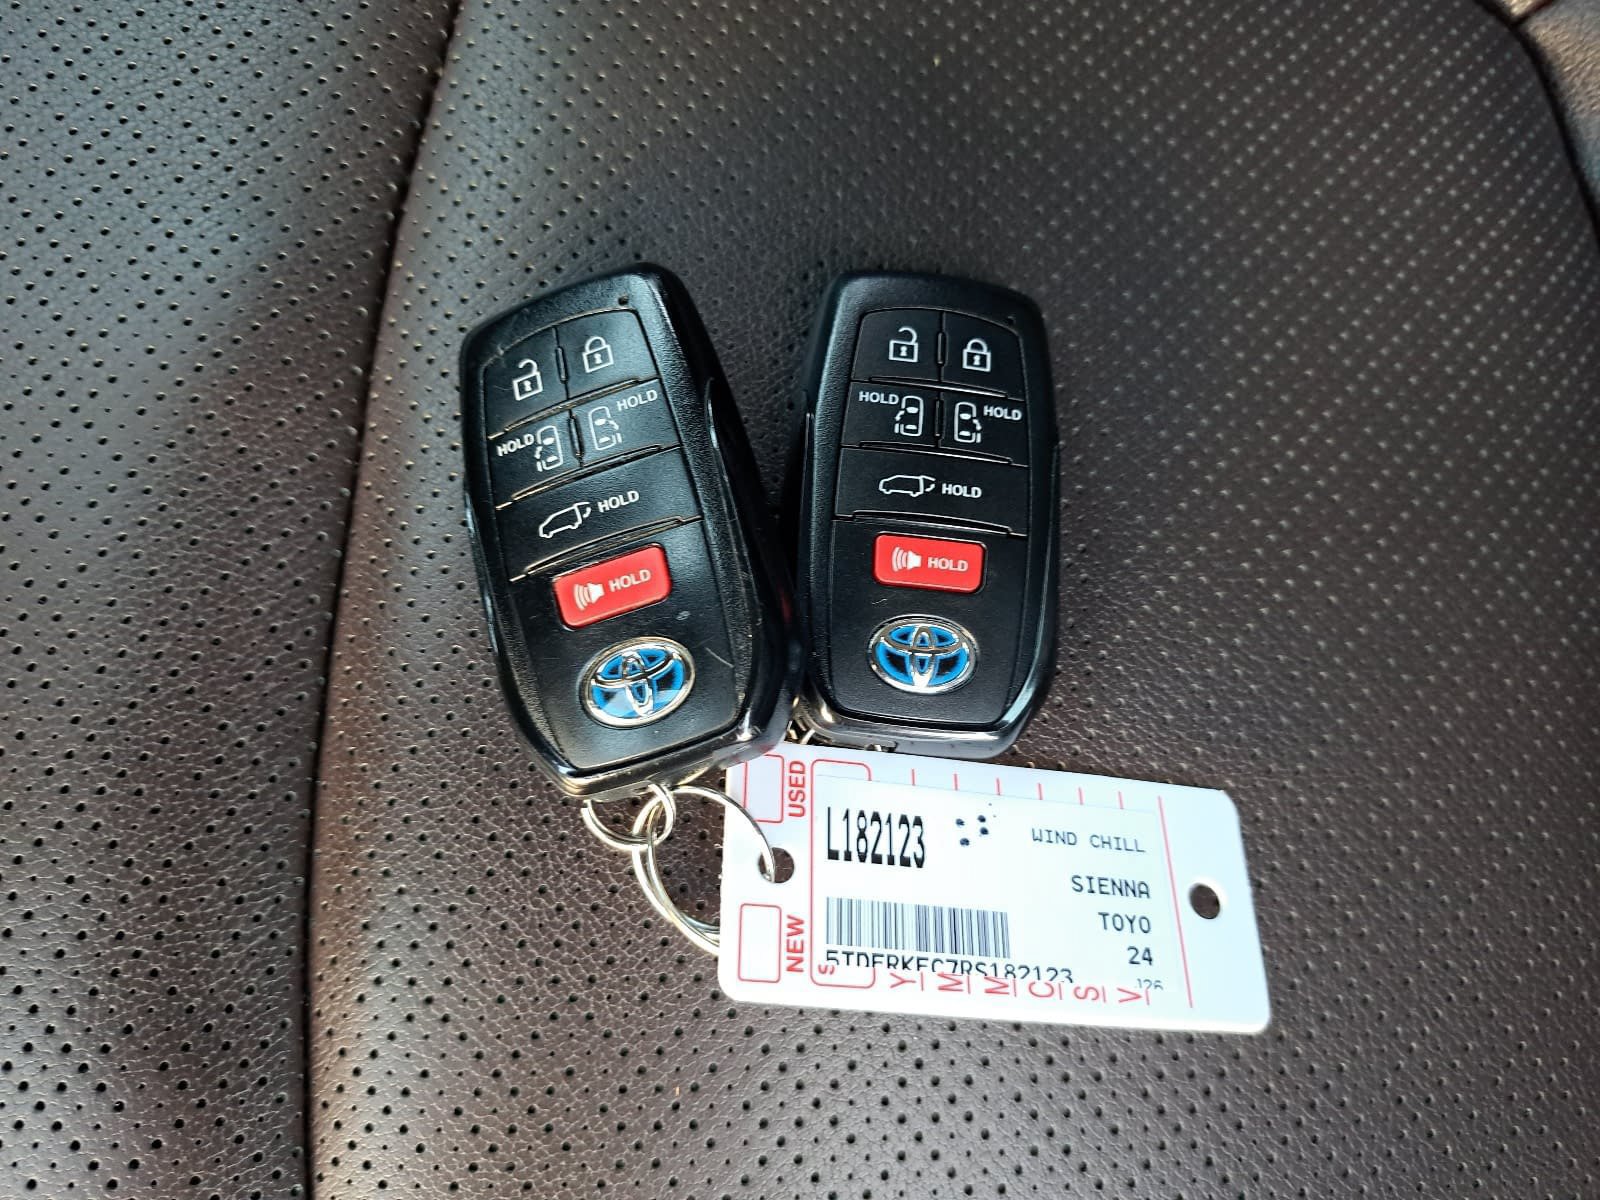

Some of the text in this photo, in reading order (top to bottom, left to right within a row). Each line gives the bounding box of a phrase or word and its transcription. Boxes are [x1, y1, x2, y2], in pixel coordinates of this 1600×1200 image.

[616, 389, 658, 412] HOLD
[858, 391, 899, 405] HOLD
[983, 404, 1023, 421] HOLD
[497, 433, 535, 457] HOLD
[597, 490, 640, 513] HOLD
[941, 483, 982, 498] HOLD
[927, 557, 969, 572] HOLD
[608, 568, 651, 592] HOLD
[788, 760, 806, 818] USED
[827, 806, 926, 868] L182123
[1031, 827, 1146, 853] WIND CHILL
[1071, 874, 1151, 899] SIENNA
[1098, 911, 1152, 934] TOYO
[786, 914, 805, 973] NEW
[1127, 945, 1153, 966] 24
